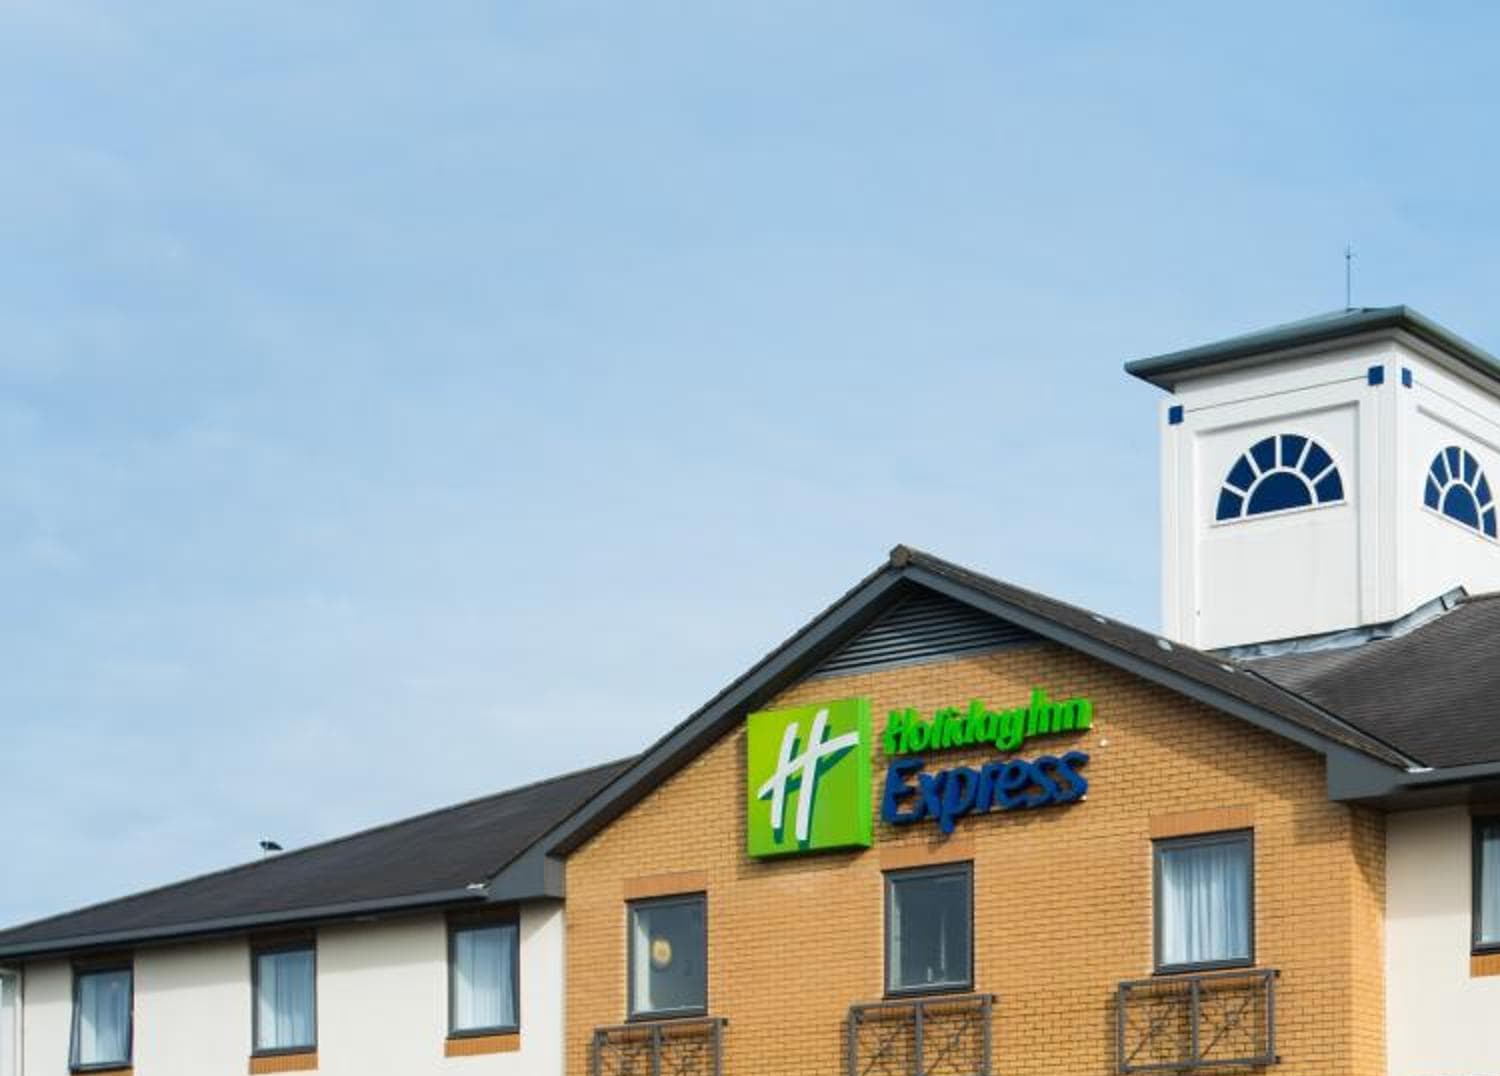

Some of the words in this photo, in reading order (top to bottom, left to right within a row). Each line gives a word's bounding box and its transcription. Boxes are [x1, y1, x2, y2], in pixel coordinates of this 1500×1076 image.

[884, 699, 1027, 753] Holiday
[1027, 687, 1093, 735] Inn
[882, 751, 1090, 833] Express
